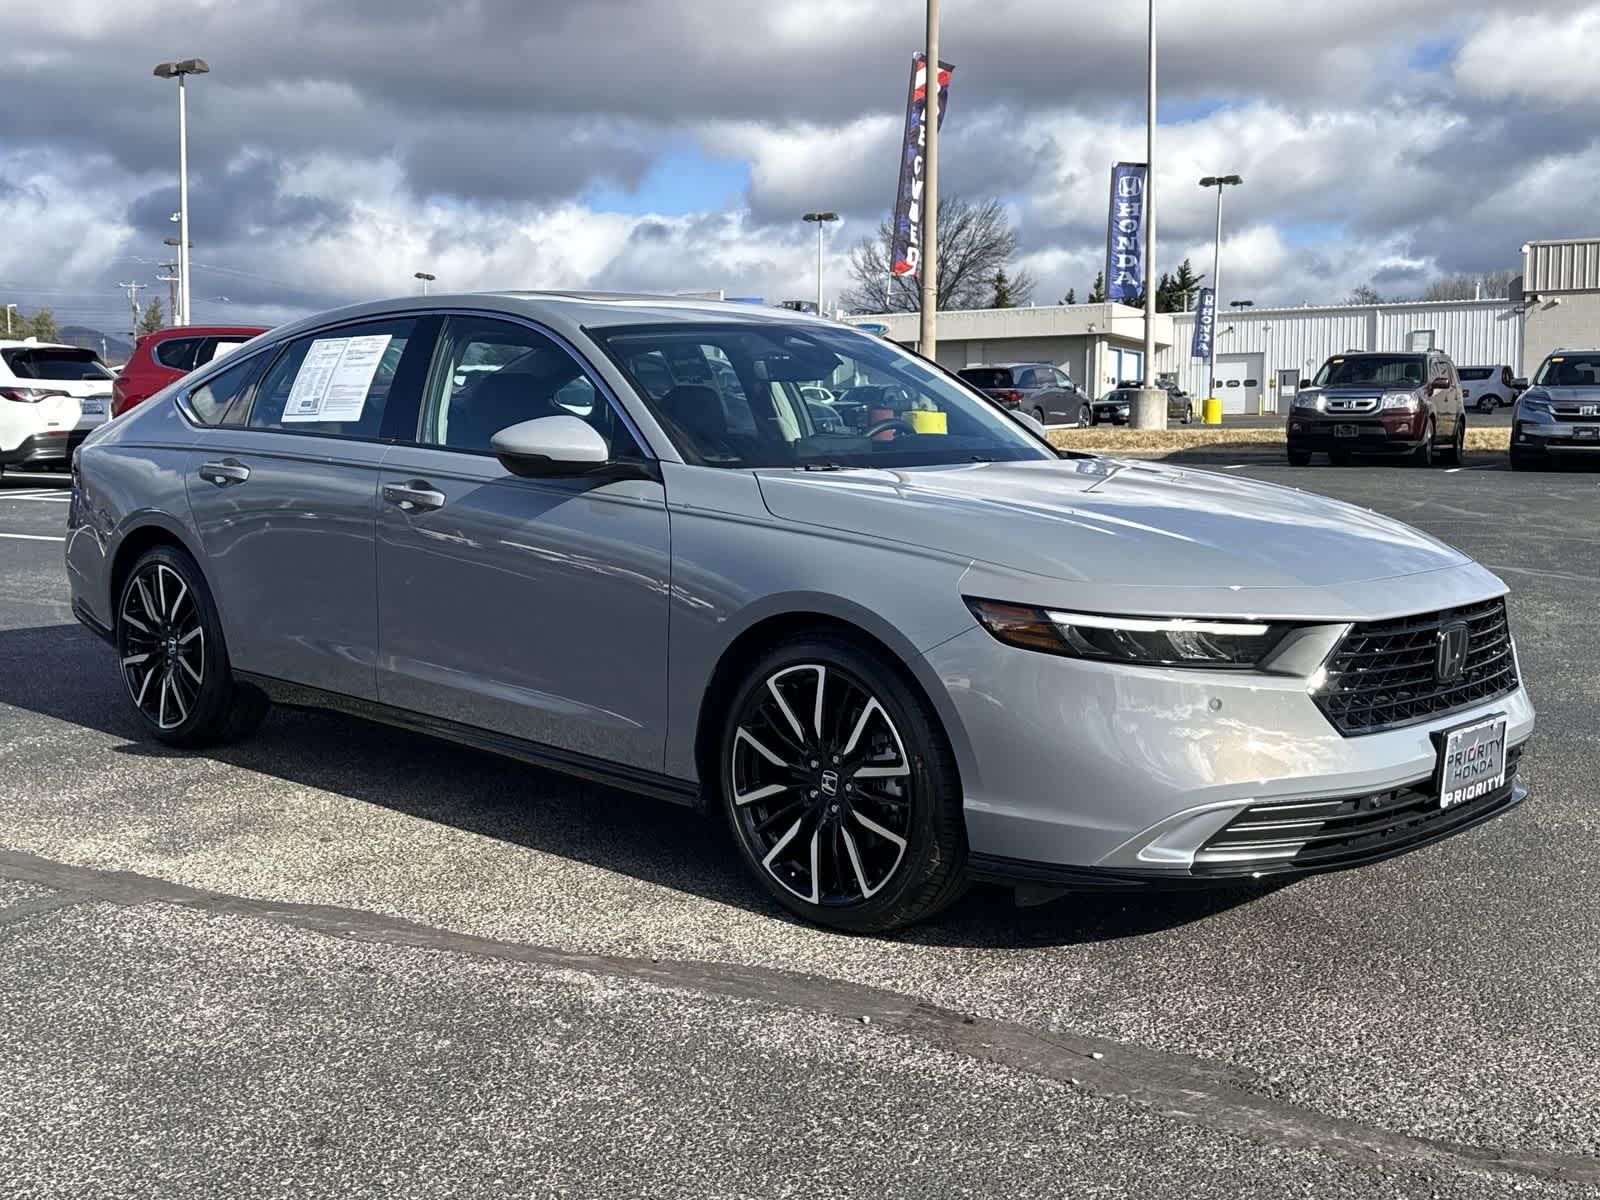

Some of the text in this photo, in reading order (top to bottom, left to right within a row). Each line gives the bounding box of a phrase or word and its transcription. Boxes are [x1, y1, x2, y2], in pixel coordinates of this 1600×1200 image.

[1114, 202, 1140, 285] HONDA
[1198, 308, 1213, 352] HONDA
[1448, 737, 1503, 767] PRIORITY
[1454, 757, 1493, 780] HONDA
[1445, 776, 1501, 805] PRIORITY
